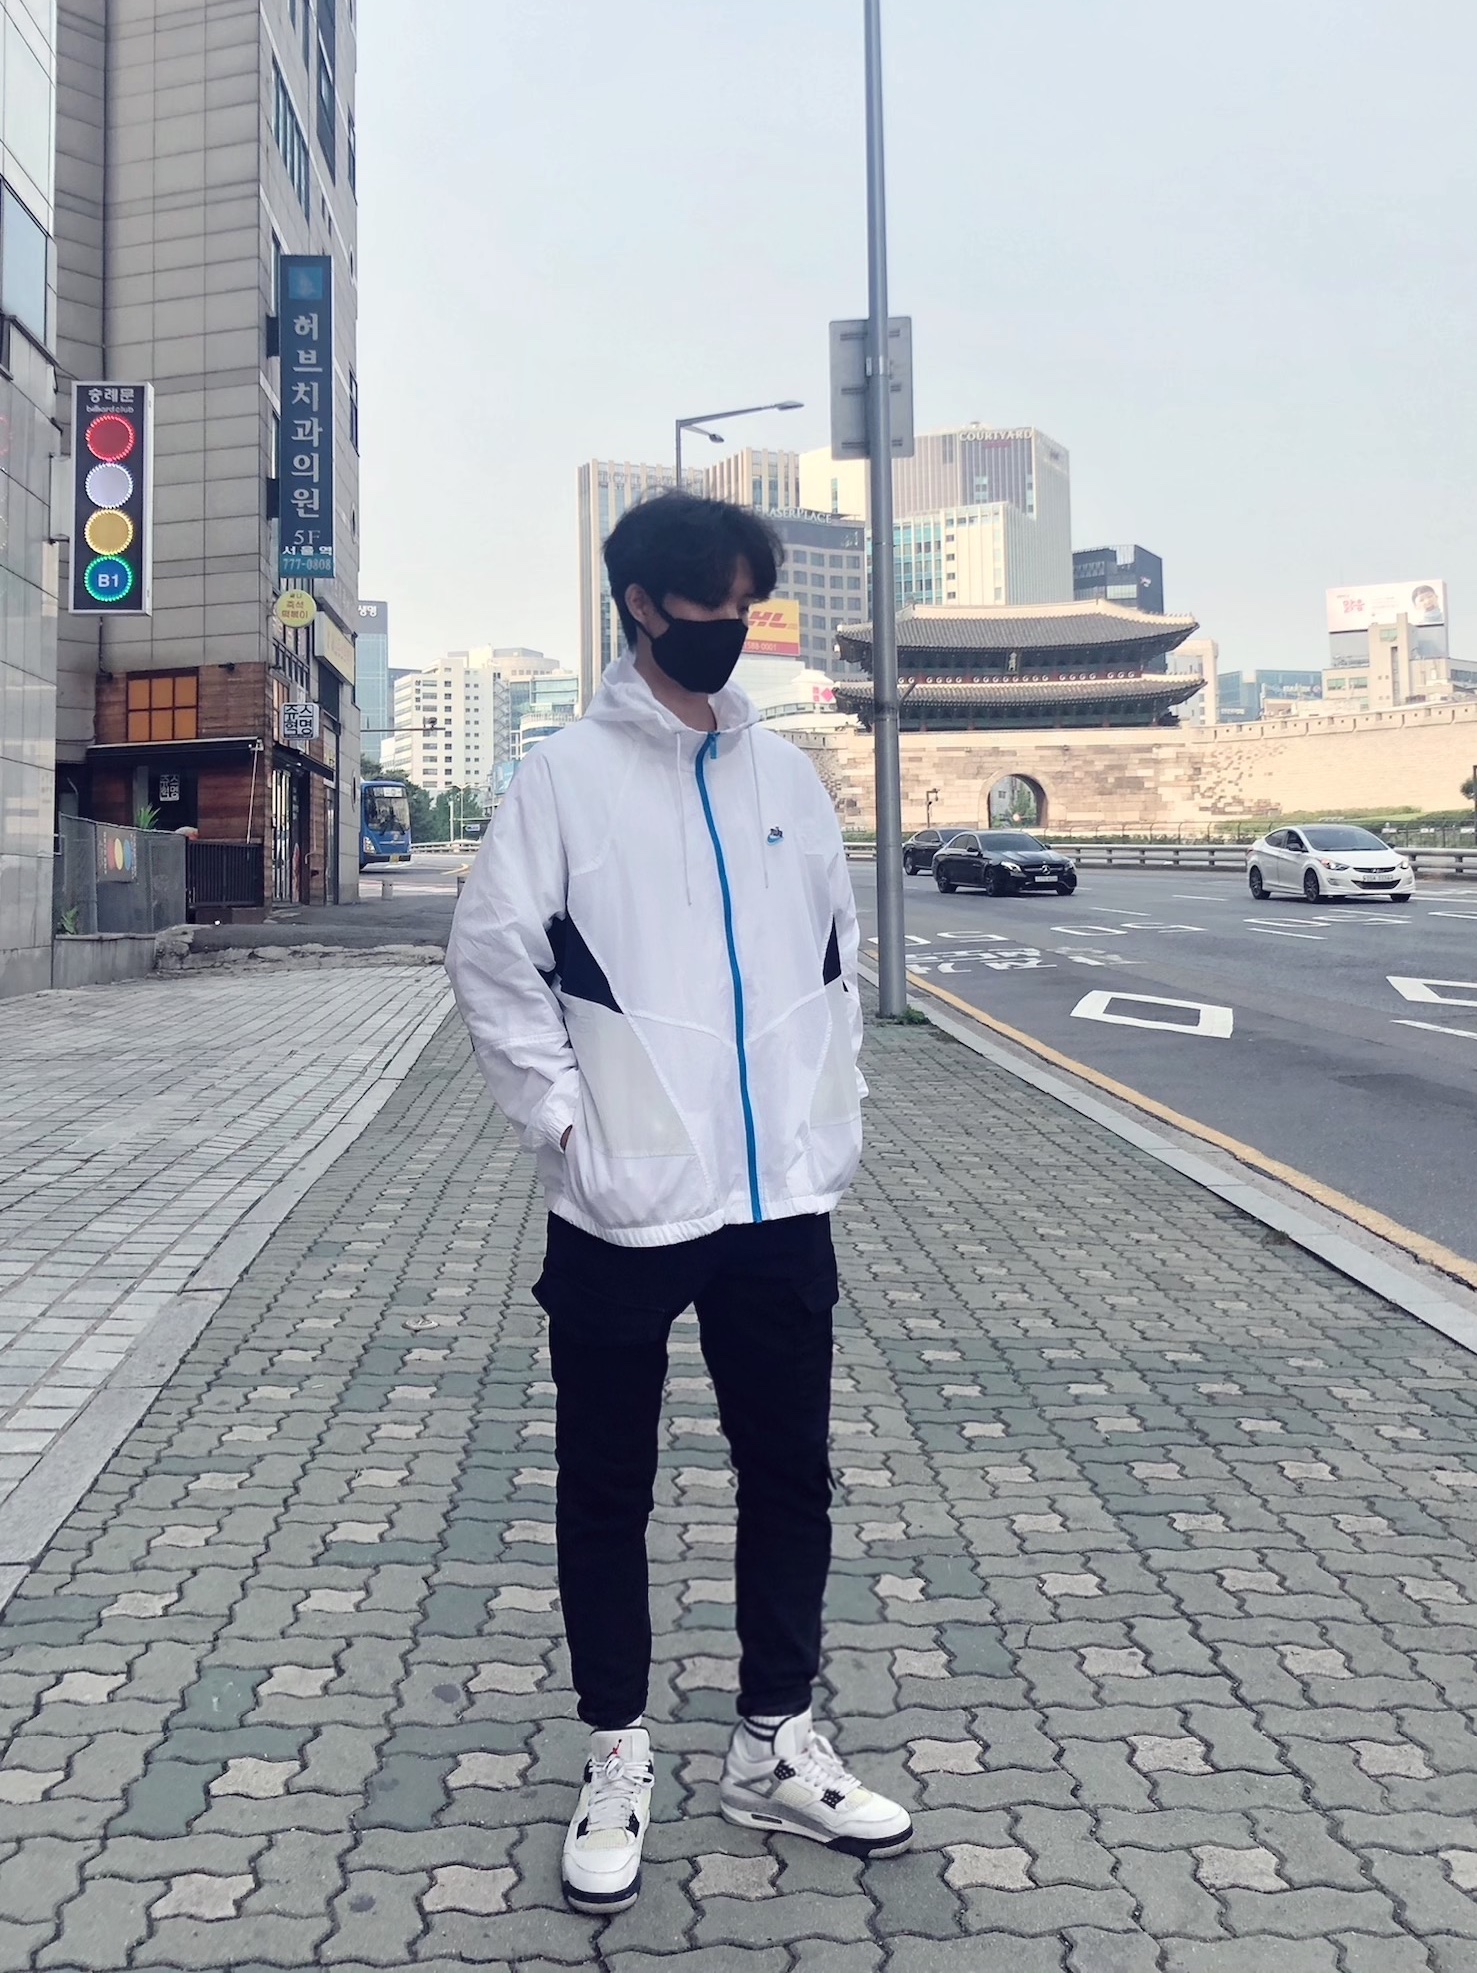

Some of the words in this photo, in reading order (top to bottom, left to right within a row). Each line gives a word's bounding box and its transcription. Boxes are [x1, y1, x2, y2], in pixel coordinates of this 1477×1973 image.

[88, 388, 135, 403] 숭례문
[291, 313, 324, 518] 허브치과의원
[960, 430, 1032, 441] COURTYARD
[293, 530, 321, 545] 5F
[282, 546, 332, 556] 서울역
[282, 558, 332, 571] 777-0808
[98, 573, 119, 588] B1
